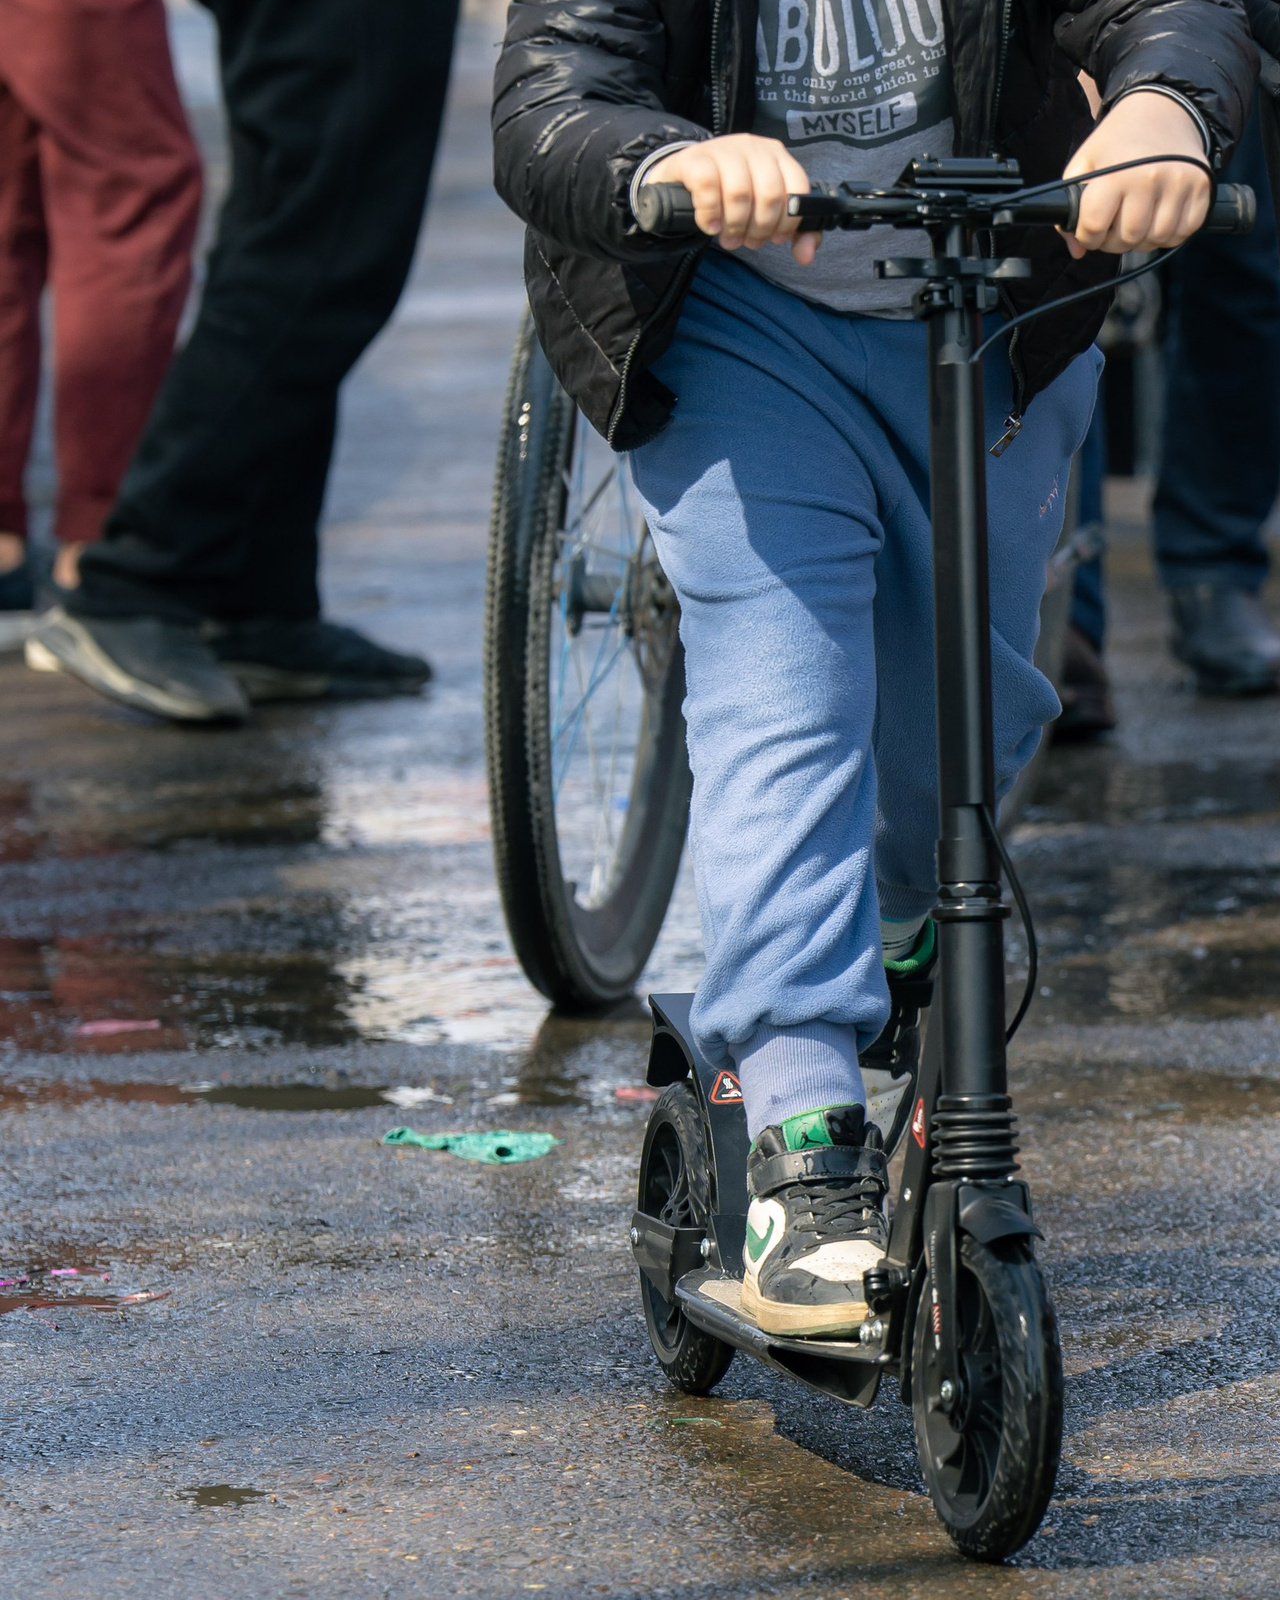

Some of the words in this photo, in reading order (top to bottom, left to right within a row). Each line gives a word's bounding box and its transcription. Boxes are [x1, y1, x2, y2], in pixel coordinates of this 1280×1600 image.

[757, 89, 778, 101] in
[783, 88, 816, 105] this
[820, 87, 868, 105] world
[873, 71, 918, 96] which
[922, 65, 940, 79] is
[779, 73, 797, 86] is
[802, 76, 837, 92] only
[843, 72, 871, 88] one
[874, 53, 916, 80] great
[801, 99, 902, 137] MYSELF
